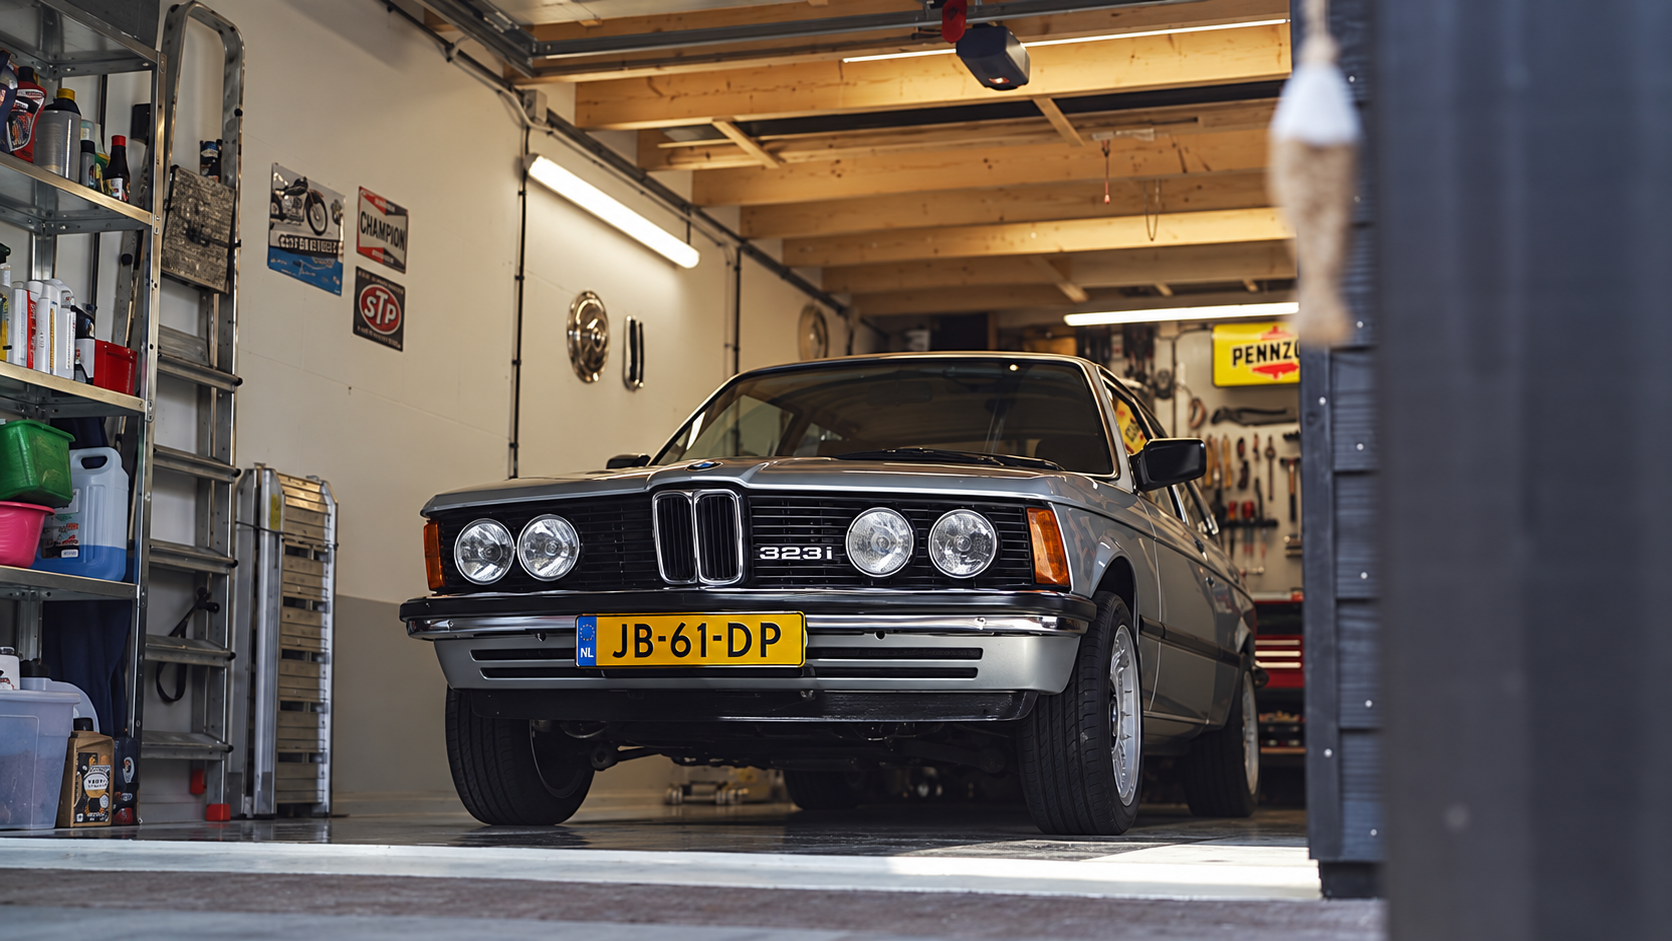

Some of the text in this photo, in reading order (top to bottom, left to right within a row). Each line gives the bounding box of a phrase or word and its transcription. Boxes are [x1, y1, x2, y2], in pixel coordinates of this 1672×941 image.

[360, 211, 405, 251] CHAMPION
[364, 290, 397, 325] STP
[759, 546, 832, 560] 323i
[580, 647, 594, 658] NL
[612, 622, 782, 659] JB-61-DP
